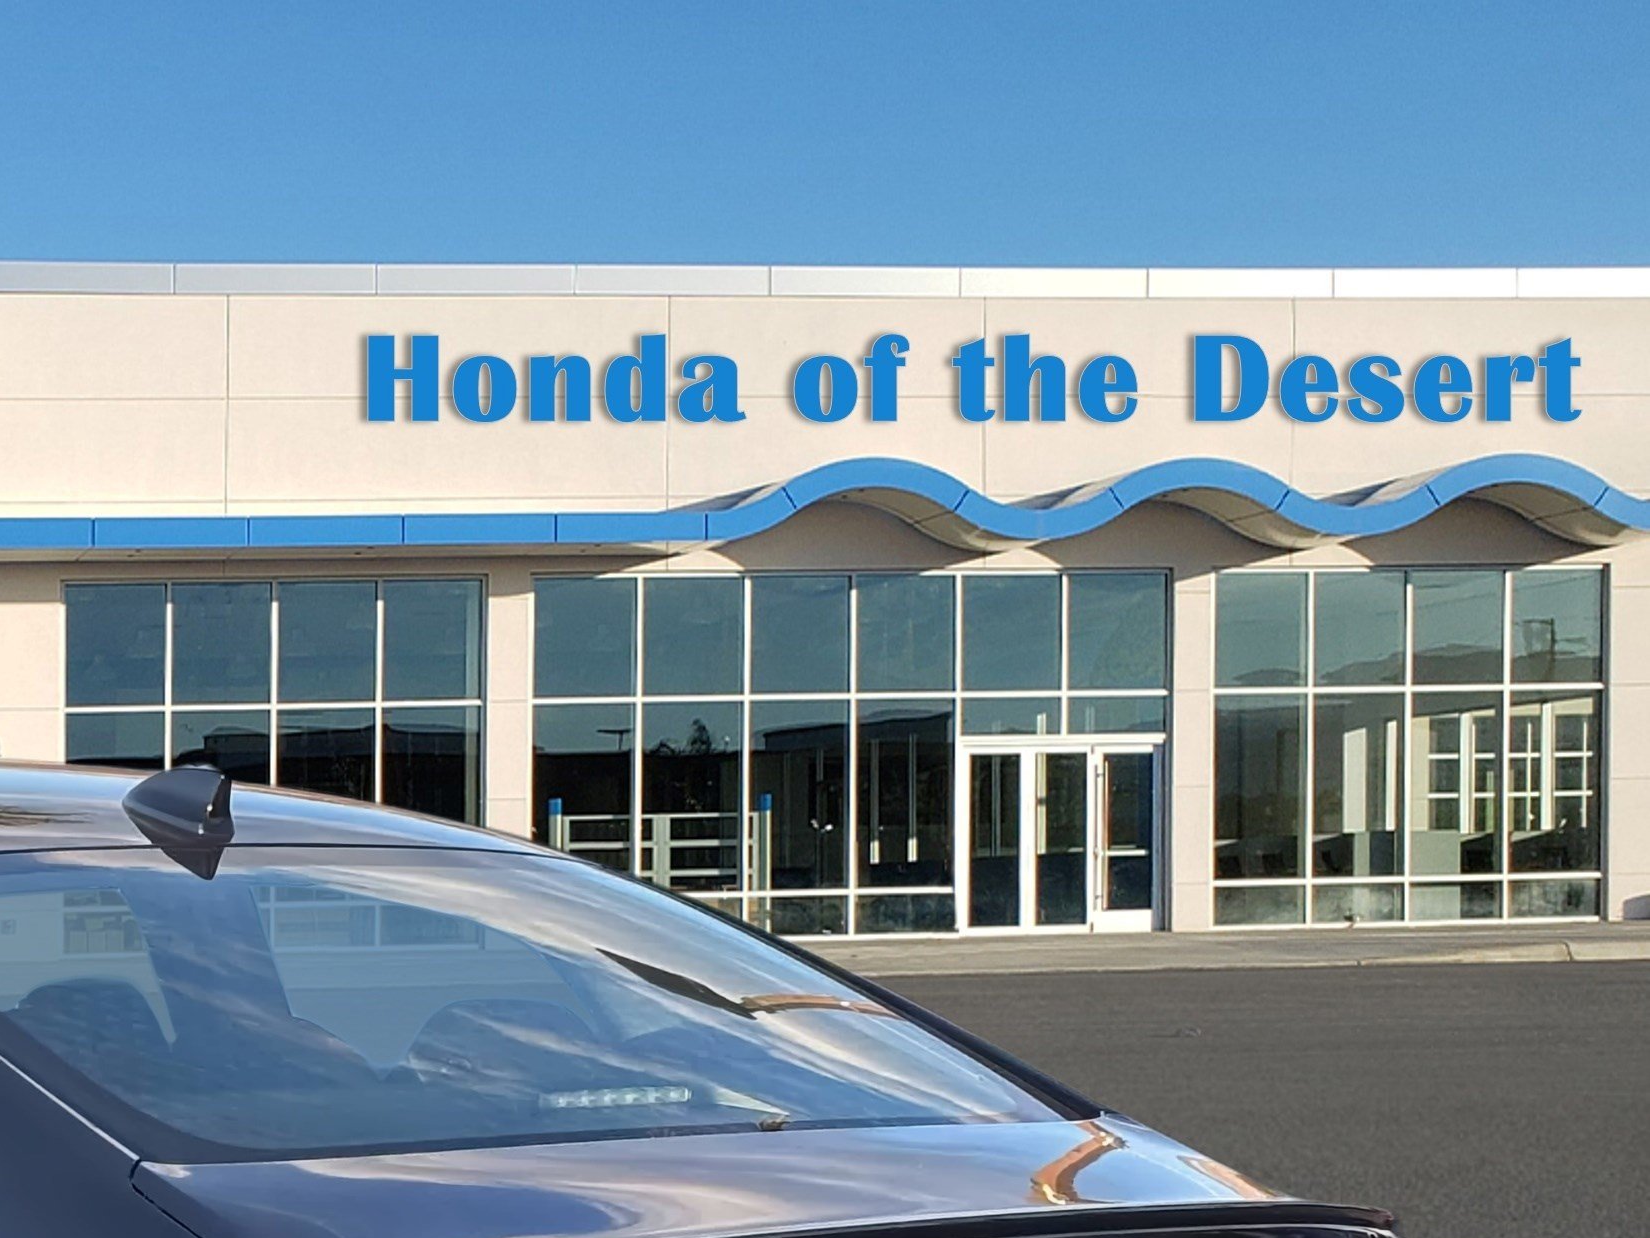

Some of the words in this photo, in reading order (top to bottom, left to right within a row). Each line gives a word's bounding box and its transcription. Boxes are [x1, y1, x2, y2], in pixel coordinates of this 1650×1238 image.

[366, 334, 746, 424] Honda
[793, 333, 910, 424] of
[951, 334, 1139, 424] the
[1192, 335, 1581, 424] Desert
